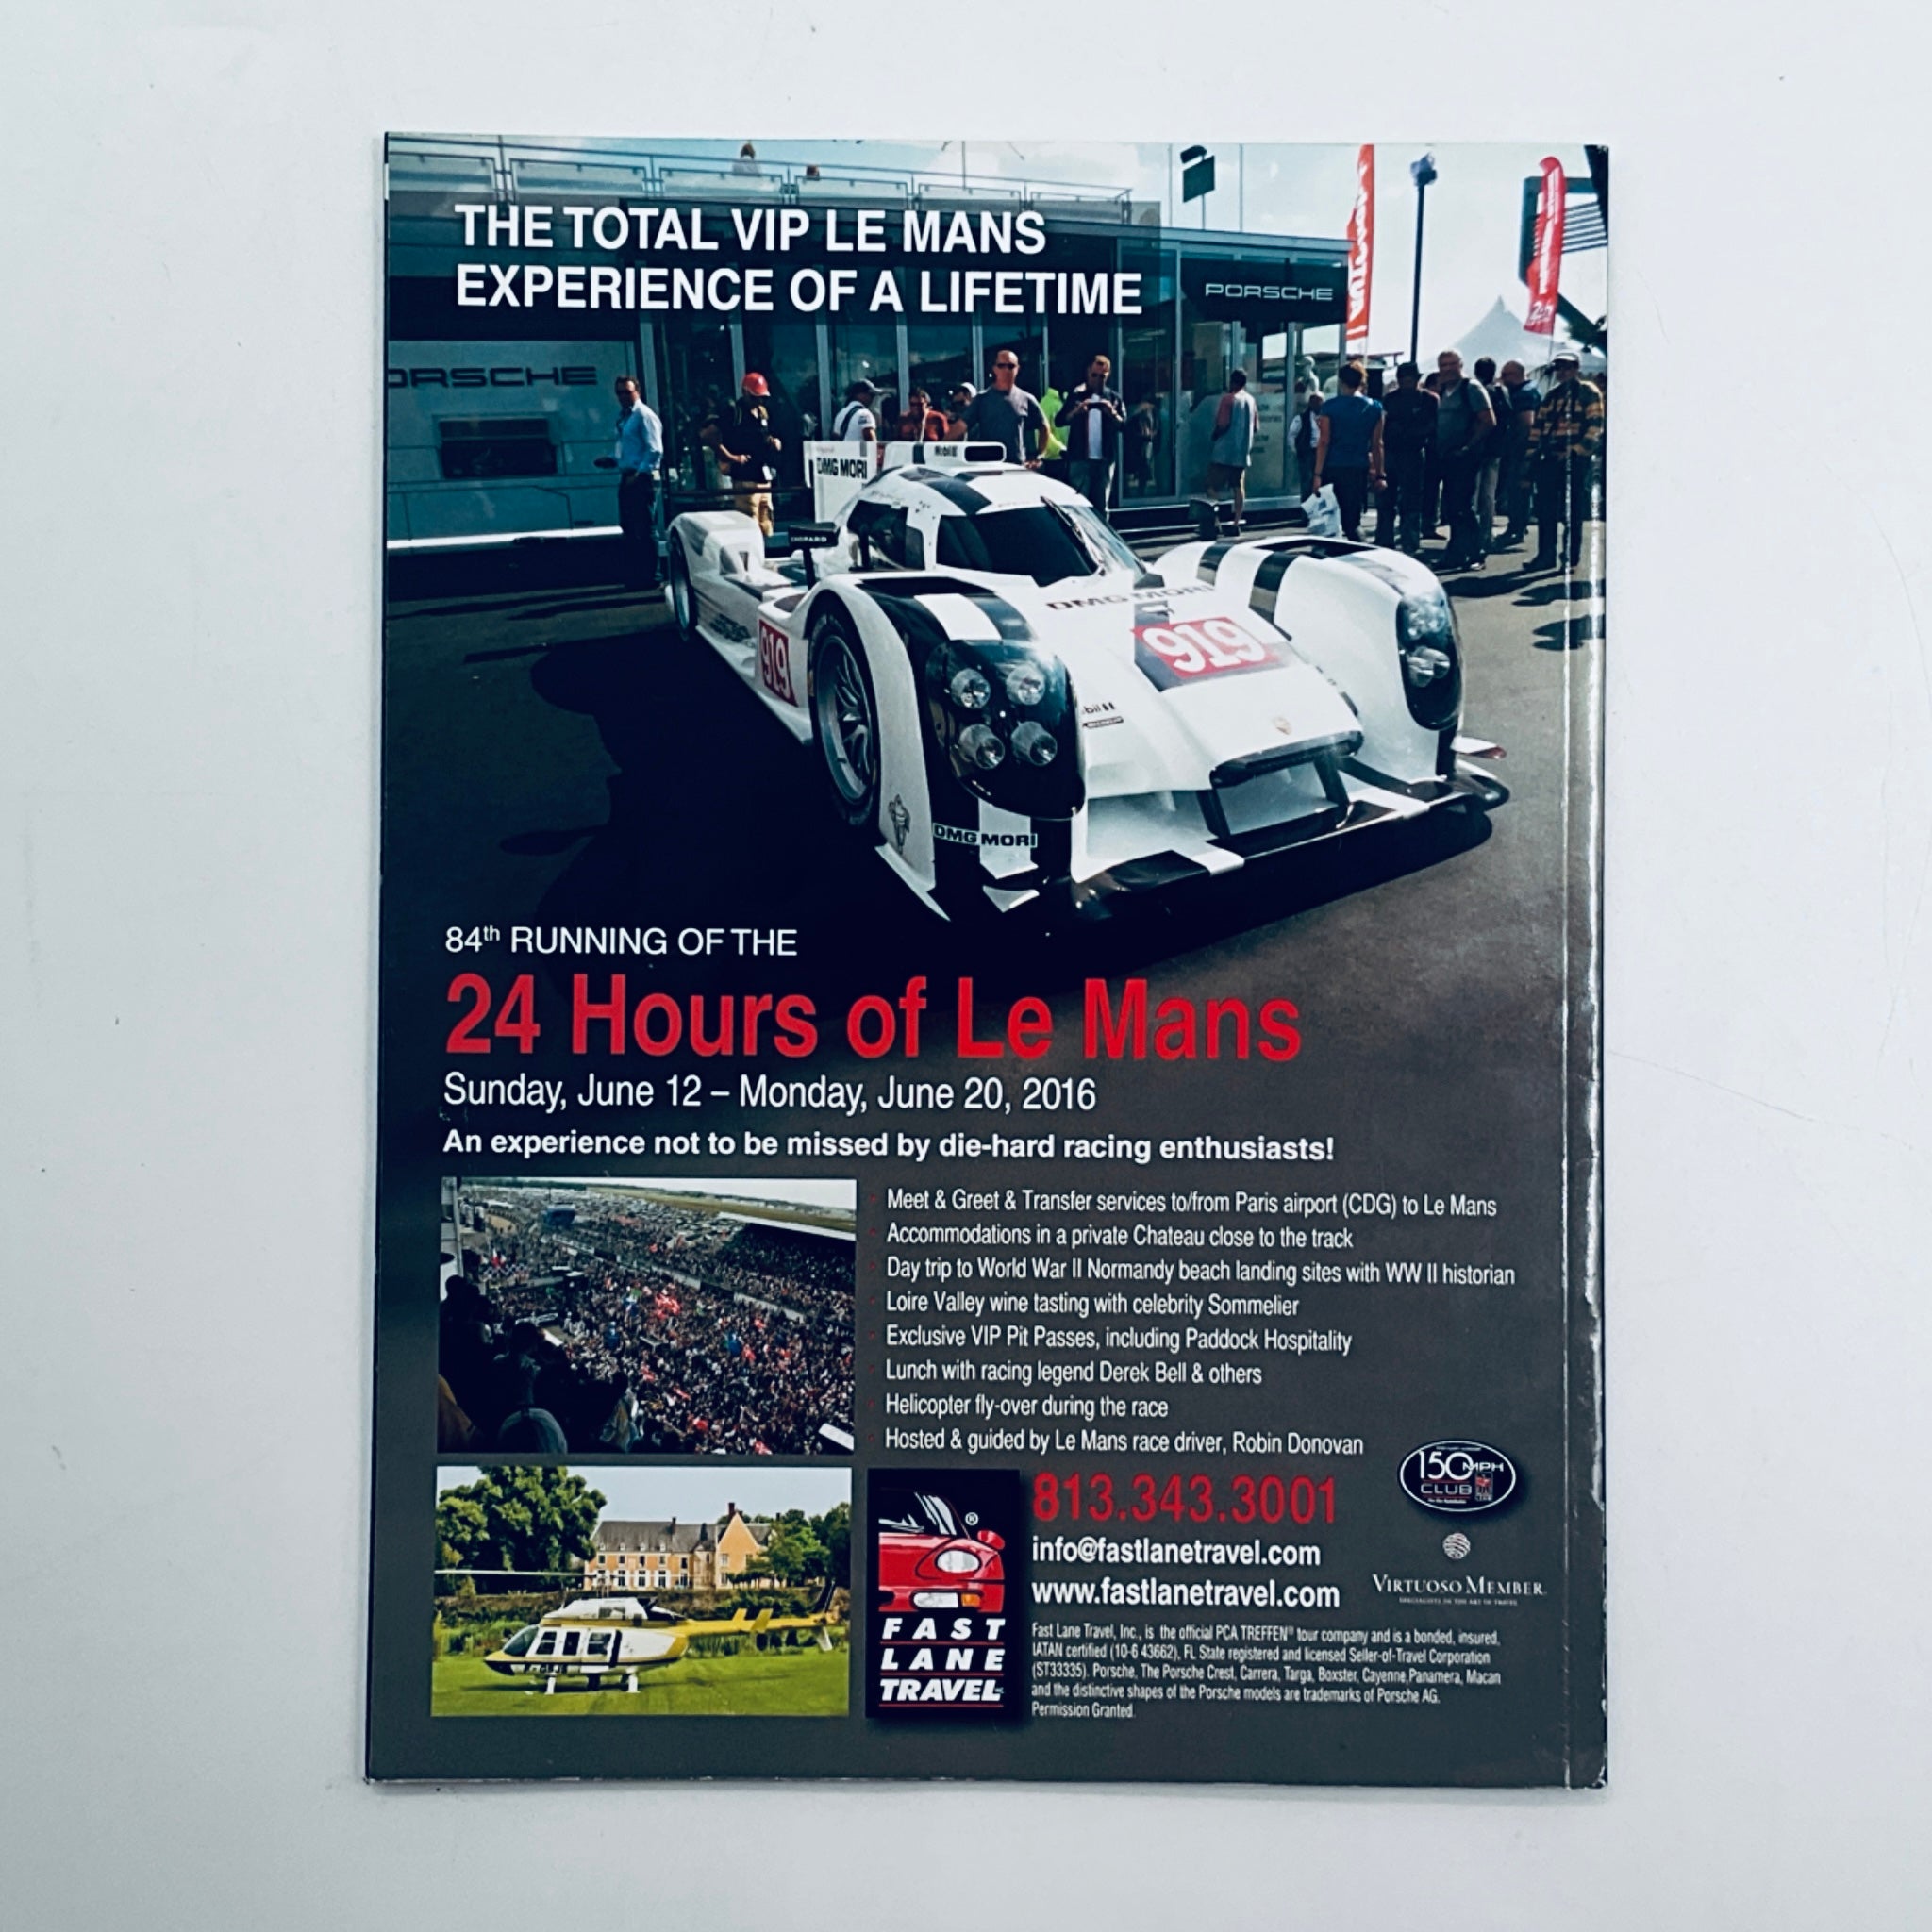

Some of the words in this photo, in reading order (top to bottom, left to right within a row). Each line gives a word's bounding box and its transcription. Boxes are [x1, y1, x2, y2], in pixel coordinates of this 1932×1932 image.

[454, 204, 553, 246] THE
[562, 206, 718, 251] TOTAL
[731, 208, 808, 251] VIP
[826, 209, 885, 251] LE
[904, 208, 1045, 254] MANS
[458, 264, 773, 310] EXPERIENCE
[791, 268, 857, 311] OF
[870, 270, 903, 311] A
[921, 271, 1141, 314] LIFETIME
[1205, 283, 1334, 301] PORSCHE
[840, 458, 867, 479] MORI
[1046, 593, 1128, 610] DMG
[1131, 584, 1215, 600] MORI
[1142, 619, 1266, 673] 919
[761, 625, 791, 699] 919
[934, 824, 978, 843] DMG
[980, 833, 1037, 848] MORI
[511, 926, 666, 954] RUNNING
[678, 928, 724, 955] OF
[730, 928, 796, 955] THE
[447, 974, 539, 1051] 24
[573, 974, 816, 1056] Hours
[847, 975, 925, 1057] of
[958, 977, 1052, 1058] Le
[1084, 978, 1300, 1060] Mans
[444, 1072, 565, 1113] Sunday,
[577, 1073, 653, 1106] June
[667, 1074, 700, 1106] 12
[741, 1074, 866, 1116] Monday,
[877, 1075, 953, 1108] June
[964, 1077, 1010, 1114] 20,
[1023, 1077, 1095, 1109] 2016
[443, 1129, 481, 1151] An
[491, 1129, 644, 1159] experience
[655, 1132, 699, 1154] not
[708, 1132, 735, 1154] to
[744, 1131, 777, 1154] be
[787, 1132, 887, 1156] missed
[898, 1133, 930, 1161] by
[940, 1134, 1054, 1157] die-hard
[1064, 1135, 1150, 1163] racing
[1159, 1136, 1333, 1159] enthusiasts!
[888, 1188, 928, 1208] Meet
[935, 1189, 945, 1208] &
[952, 1189, 998, 1209] Greet
[1004, 1190, 1015, 1209] &
[1022, 1190, 1091, 1210] Transfer
[1097, 1191, 1165, 1211] services
[1172, 1191, 1229, 1212] to/from
[1236, 1191, 1277, 1212] Paris
[1283, 1192, 1337, 1218] airport
[1343, 1192, 1396, 1218] (CDG)
[1402, 1195, 1418, 1214] to
[1424, 1194, 1444, 1214] Le
[1451, 1194, 1496, 1216] Mans
[887, 1222, 1030, 1244] Accommodations
[1037, 1224, 1050, 1243] in
[1056, 1228, 1066, 1244] a
[1072, 1224, 1128, 1249] private
[1133, 1224, 1204, 1245] Chateau
[1209, 1225, 1254, 1246] close
[1259, 1227, 1274, 1246] to
[1280, 1226, 1306, 1247] the
[1311, 1227, 1353, 1248] track
[888, 1256, 920, 1282] Day
[925, 1257, 951, 1282] trip
[957, 1258, 972, 1277] to
[977, 1257, 1025, 1277] World
[1032, 1257, 1066, 1278] War
[1088, 1258, 1174, 1284] Normandy
[1179, 1259, 1229, 1280] beach
[1236, 1260, 1296, 1286] landing
[1302, 1261, 1341, 1282] sites
[1346, 1262, 1379, 1282] with
[1385, 1262, 1421, 1282] WW
[1443, 1263, 1514, 1284] historian
[887, 1291, 927, 1311] Loire
[934, 1291, 984, 1316] Valley
[990, 1291, 1028, 1312] wine
[1034, 1291, 1089, 1318] tasting
[1094, 1292, 1126, 1312] with
[1133, 1293, 1203, 1319] celebrity
[1208, 1293, 1298, 1315] Sommelier
[887, 1324, 965, 1345] Exclusive
[971, 1325, 1000, 1345] VIP
[1008, 1325, 1027, 1346] Pit
[1034, 1325, 1099, 1349] Passes,
[1106, 1326, 1179, 1353] including
[1186, 1327, 1258, 1349] Paddock
[1264, 1328, 1351, 1356] Hospitality
[887, 1358, 936, 1379] Lunch
[941, 1359, 974, 1380] with
[981, 1360, 1031, 1386] racing
[1038, 1360, 1093, 1387] legend
[1100, 1360, 1149, 1382] Derek
[1155, 1361, 1185, 1382] Bell
[1191, 1362, 1203, 1383] &
[1209, 1362, 1261, 1383] others
[887, 1393, 970, 1419] Helicopter
[975, 1394, 1037, 1420] fly-over
[1042, 1394, 1094, 1421] during
[1100, 1395, 1125, 1416] the
[1132, 1401, 1168, 1416] race
[886, 1427, 944, 1448] Hosted
[950, 1428, 961, 1448] &
[968, 1428, 1024, 1454] guided
[1030, 1429, 1049, 1455] by
[1056, 1429, 1075, 1450] Le
[1081, 1429, 1126, 1450] Mans
[1133, 1435, 1169, 1451] race
[1174, 1431, 1225, 1454] driver,
[1233, 1431, 1281, 1453] Robin
[1288, 1432, 1362, 1454] Donovan
[1419, 1451, 1474, 1480] 150
[1462, 1462, 1504, 1472] MPH
[1033, 1472, 1333, 1523] 813.343.3001
[1421, 1483, 1472, 1494] CLUB
[1033, 1536, 1320, 1564] info@fastlanetravel.com
[1032, 1576, 1339, 1607] www.fastlanetravel.com
[1372, 1574, 1462, 1594] VIRTUOSO
[882, 1617, 1006, 1641] FAST
[1032, 1622, 1053, 1637] Fast
[1057, 1623, 1080, 1638] Lane
[1145, 1624, 1154, 1639] is
[1160, 1624, 1175, 1639] the
[1179, 1624, 1212, 1640] official
[1216, 1624, 1238, 1640] PCA
[1296, 1627, 1318, 1641] tour
[1321, 1630, 1368, 1644] company
[1371, 1628, 1390, 1642] and
[1392, 1631, 1402, 1642] is
[1405, 1631, 1410, 1642] a
[1458, 1630, 1499, 1644] insured.
[881, 1648, 1006, 1671] LANE
[880, 1678, 1002, 1702] TRAVEL
[1032, 1701, 1089, 1717] Permission
